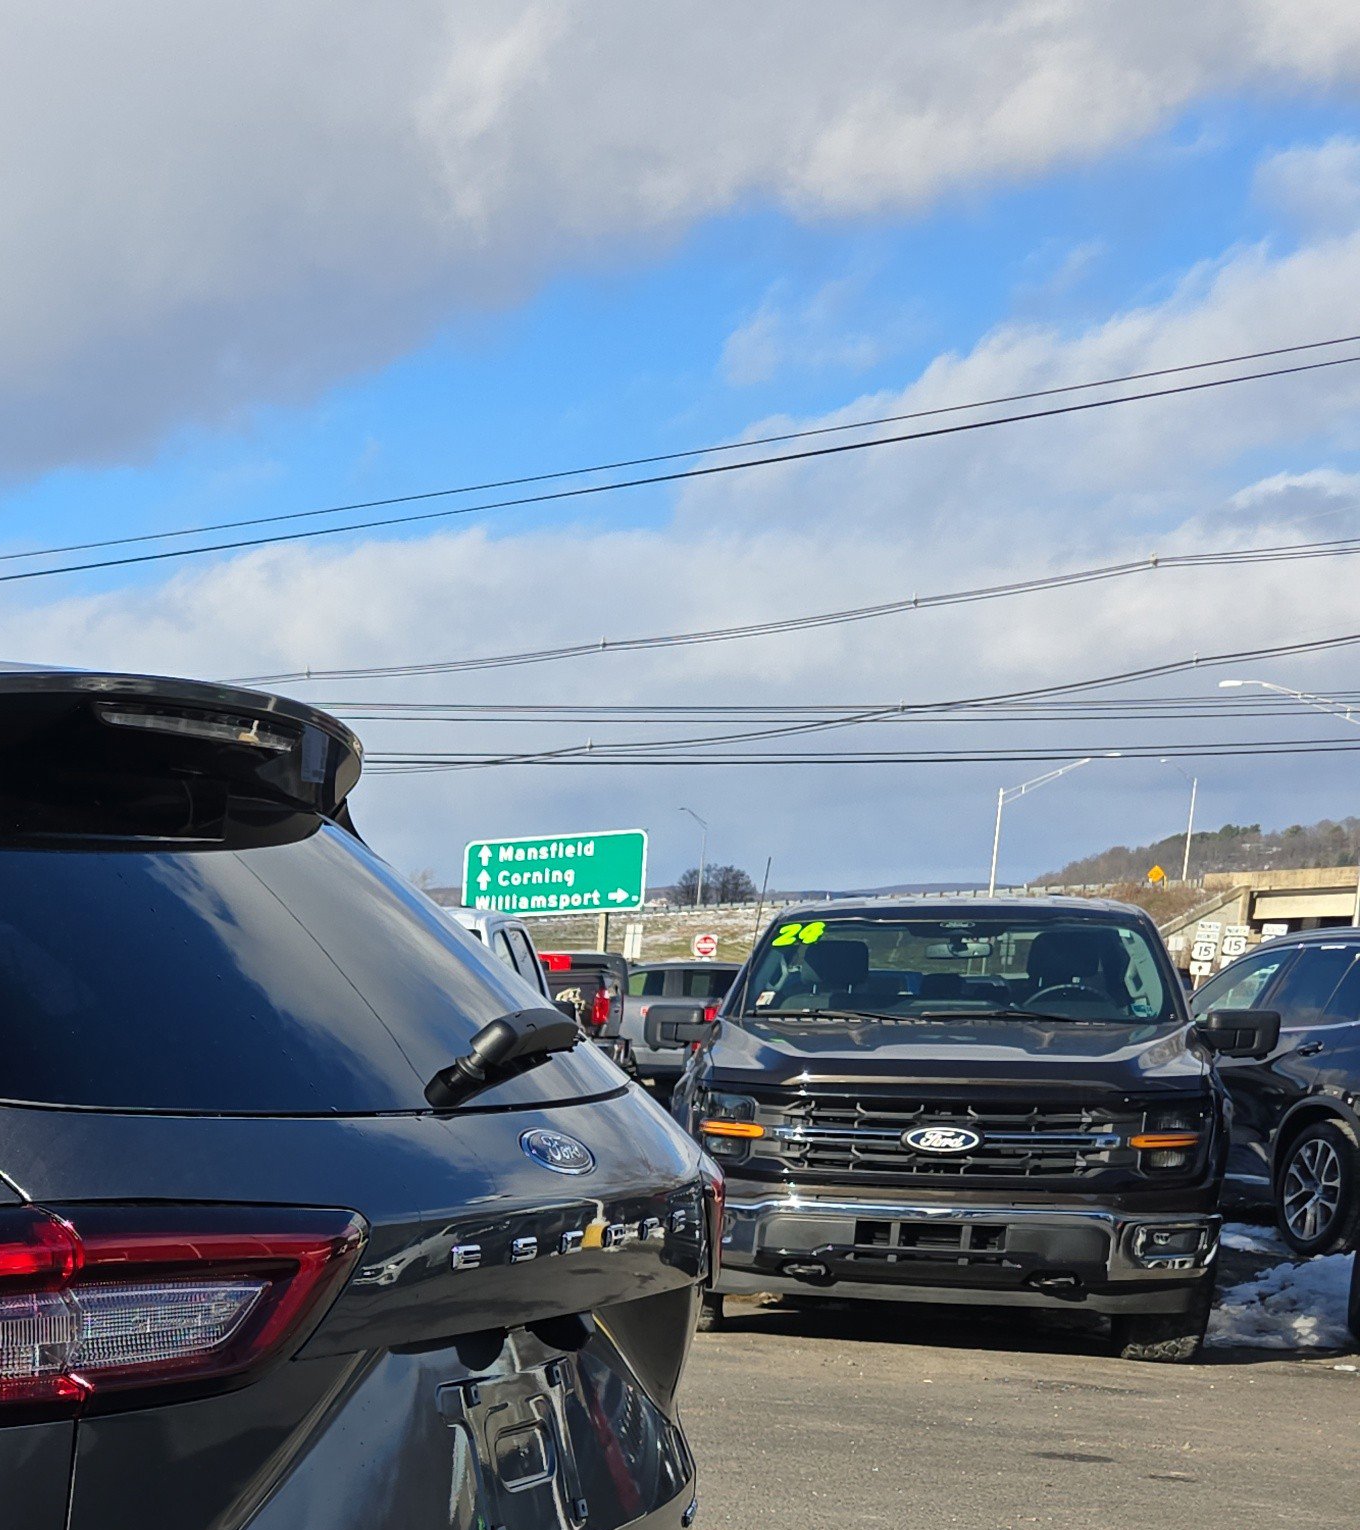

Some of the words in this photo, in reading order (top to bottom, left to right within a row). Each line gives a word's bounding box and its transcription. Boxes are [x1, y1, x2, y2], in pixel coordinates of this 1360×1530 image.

[498, 840, 594, 862] Mansfield
[497, 868, 575, 887] Corning
[475, 889, 600, 911] Williamsport
[772, 921, 826, 946] 24
[1198, 946, 1211, 957] 15
[1229, 940, 1241, 951] 15
[920, 1130, 966, 1148] Ford
[452, 1210, 686, 1271] ESCAPE
